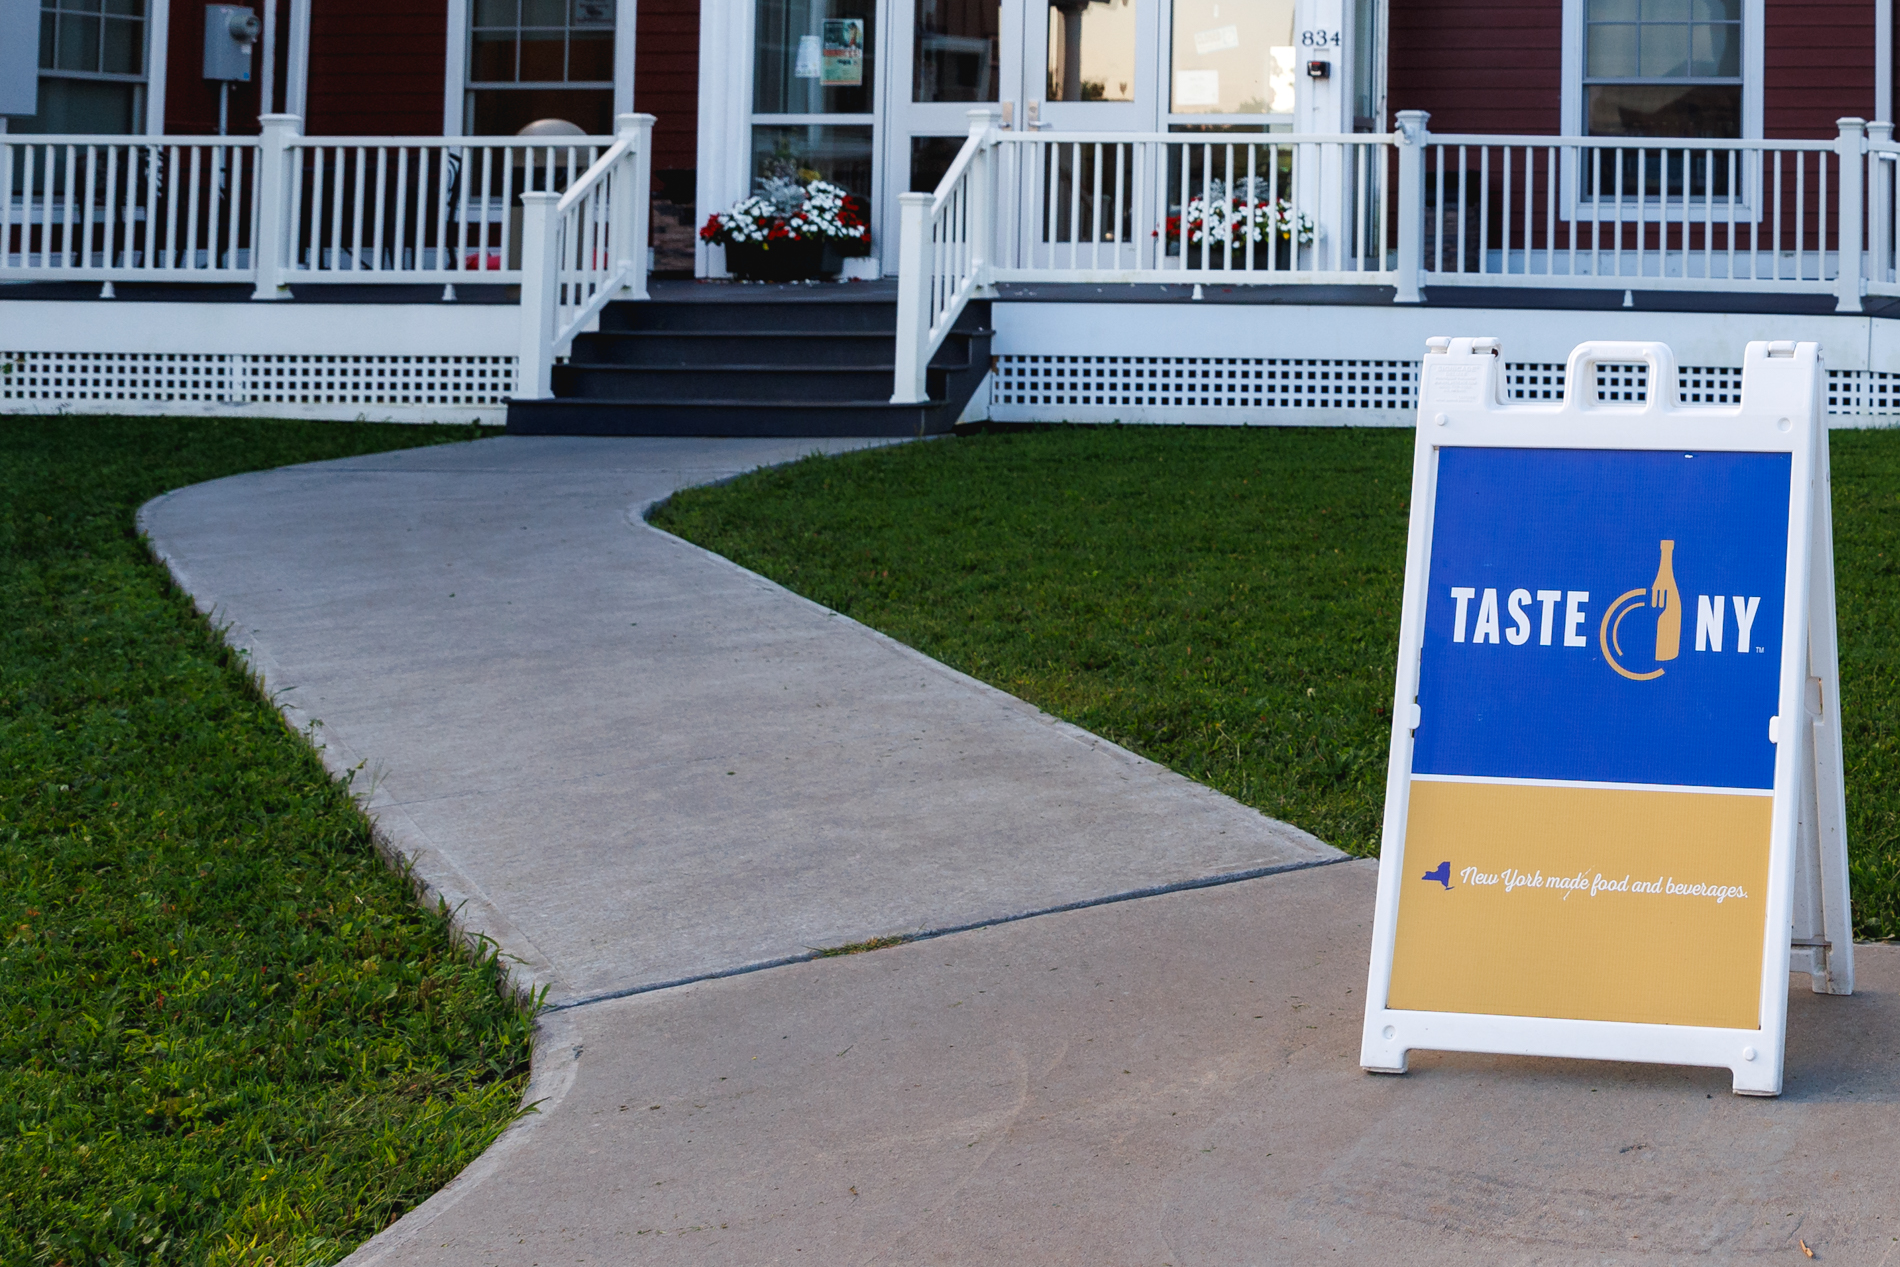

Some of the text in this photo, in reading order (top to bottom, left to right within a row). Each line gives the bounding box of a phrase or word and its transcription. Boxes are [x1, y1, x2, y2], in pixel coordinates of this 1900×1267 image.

[1301, 29, 1342, 47] 834
[1450, 586, 1590, 647] TASTE
[1695, 594, 1761, 654] NY
[1460, 866, 1749, 904] New York made food and beverages.
